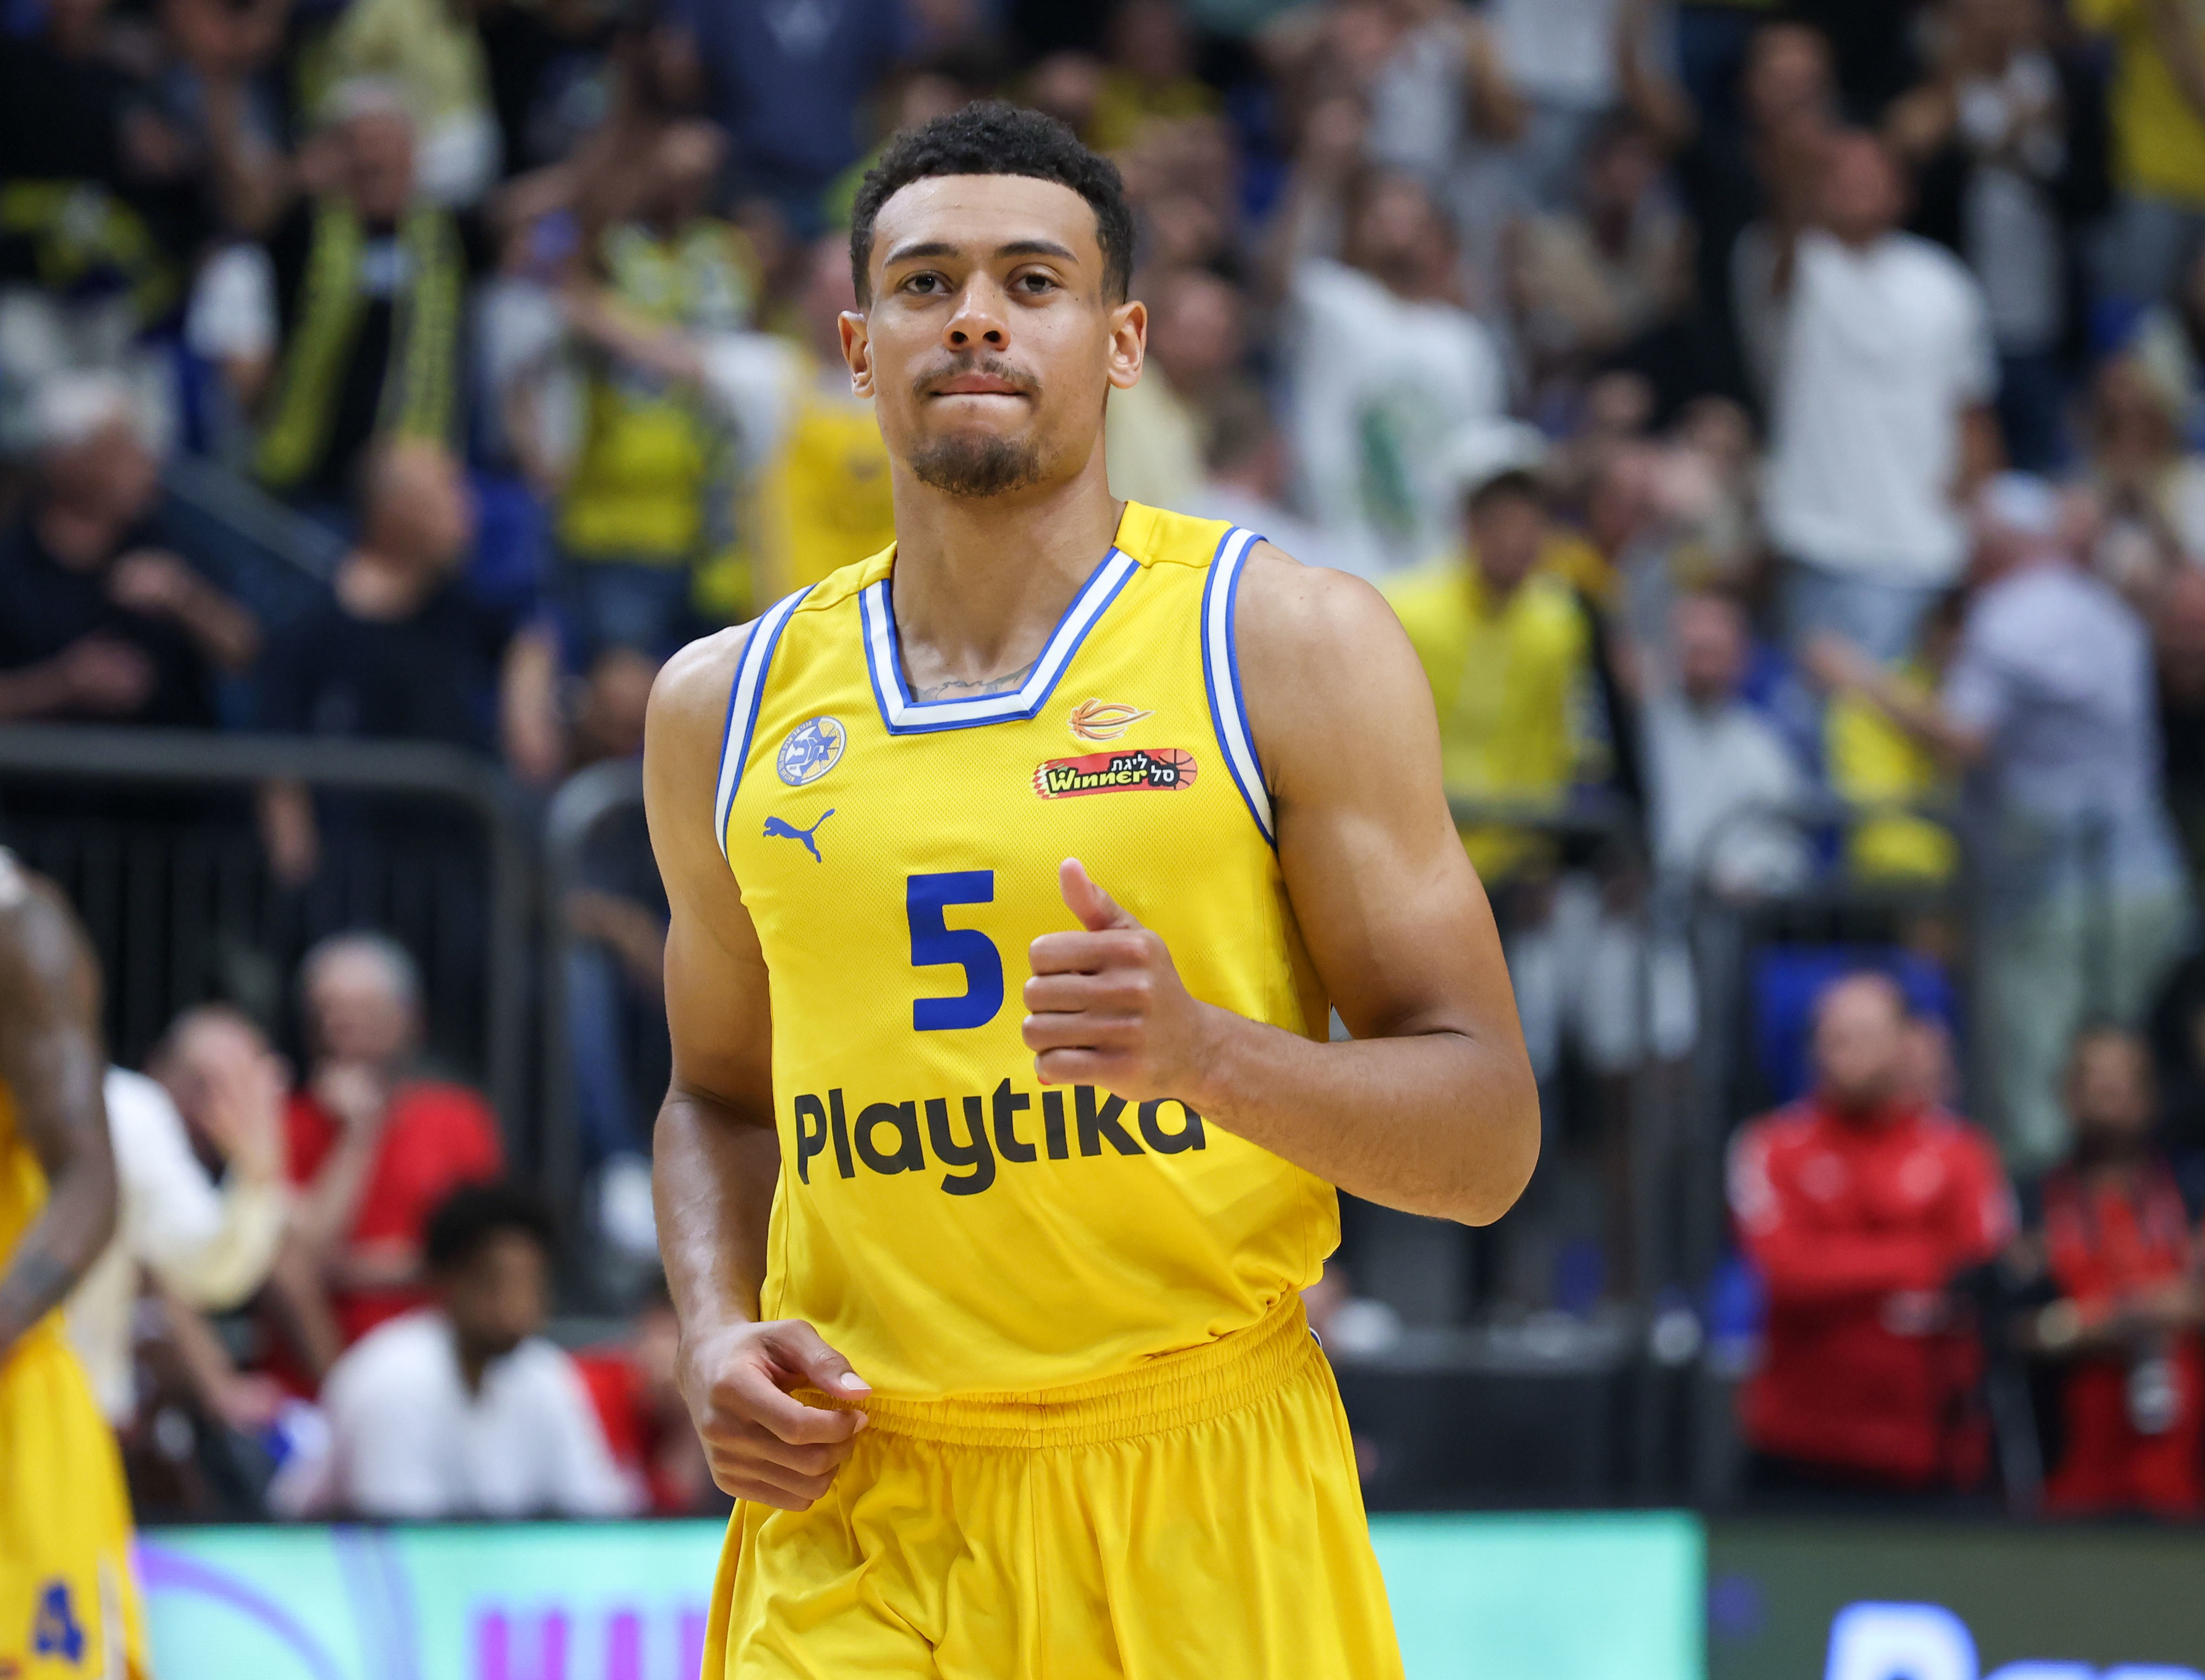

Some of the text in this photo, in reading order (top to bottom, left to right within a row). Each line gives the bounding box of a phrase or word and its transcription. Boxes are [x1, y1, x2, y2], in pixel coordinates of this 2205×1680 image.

[1111, 753, 1148, 772] ליגת
[1150, 764, 1175, 782] סל
[1048, 769, 1148, 792] Winner
[906, 869, 1004, 1031] 5
[794, 1078, 1206, 1196] Playtika
